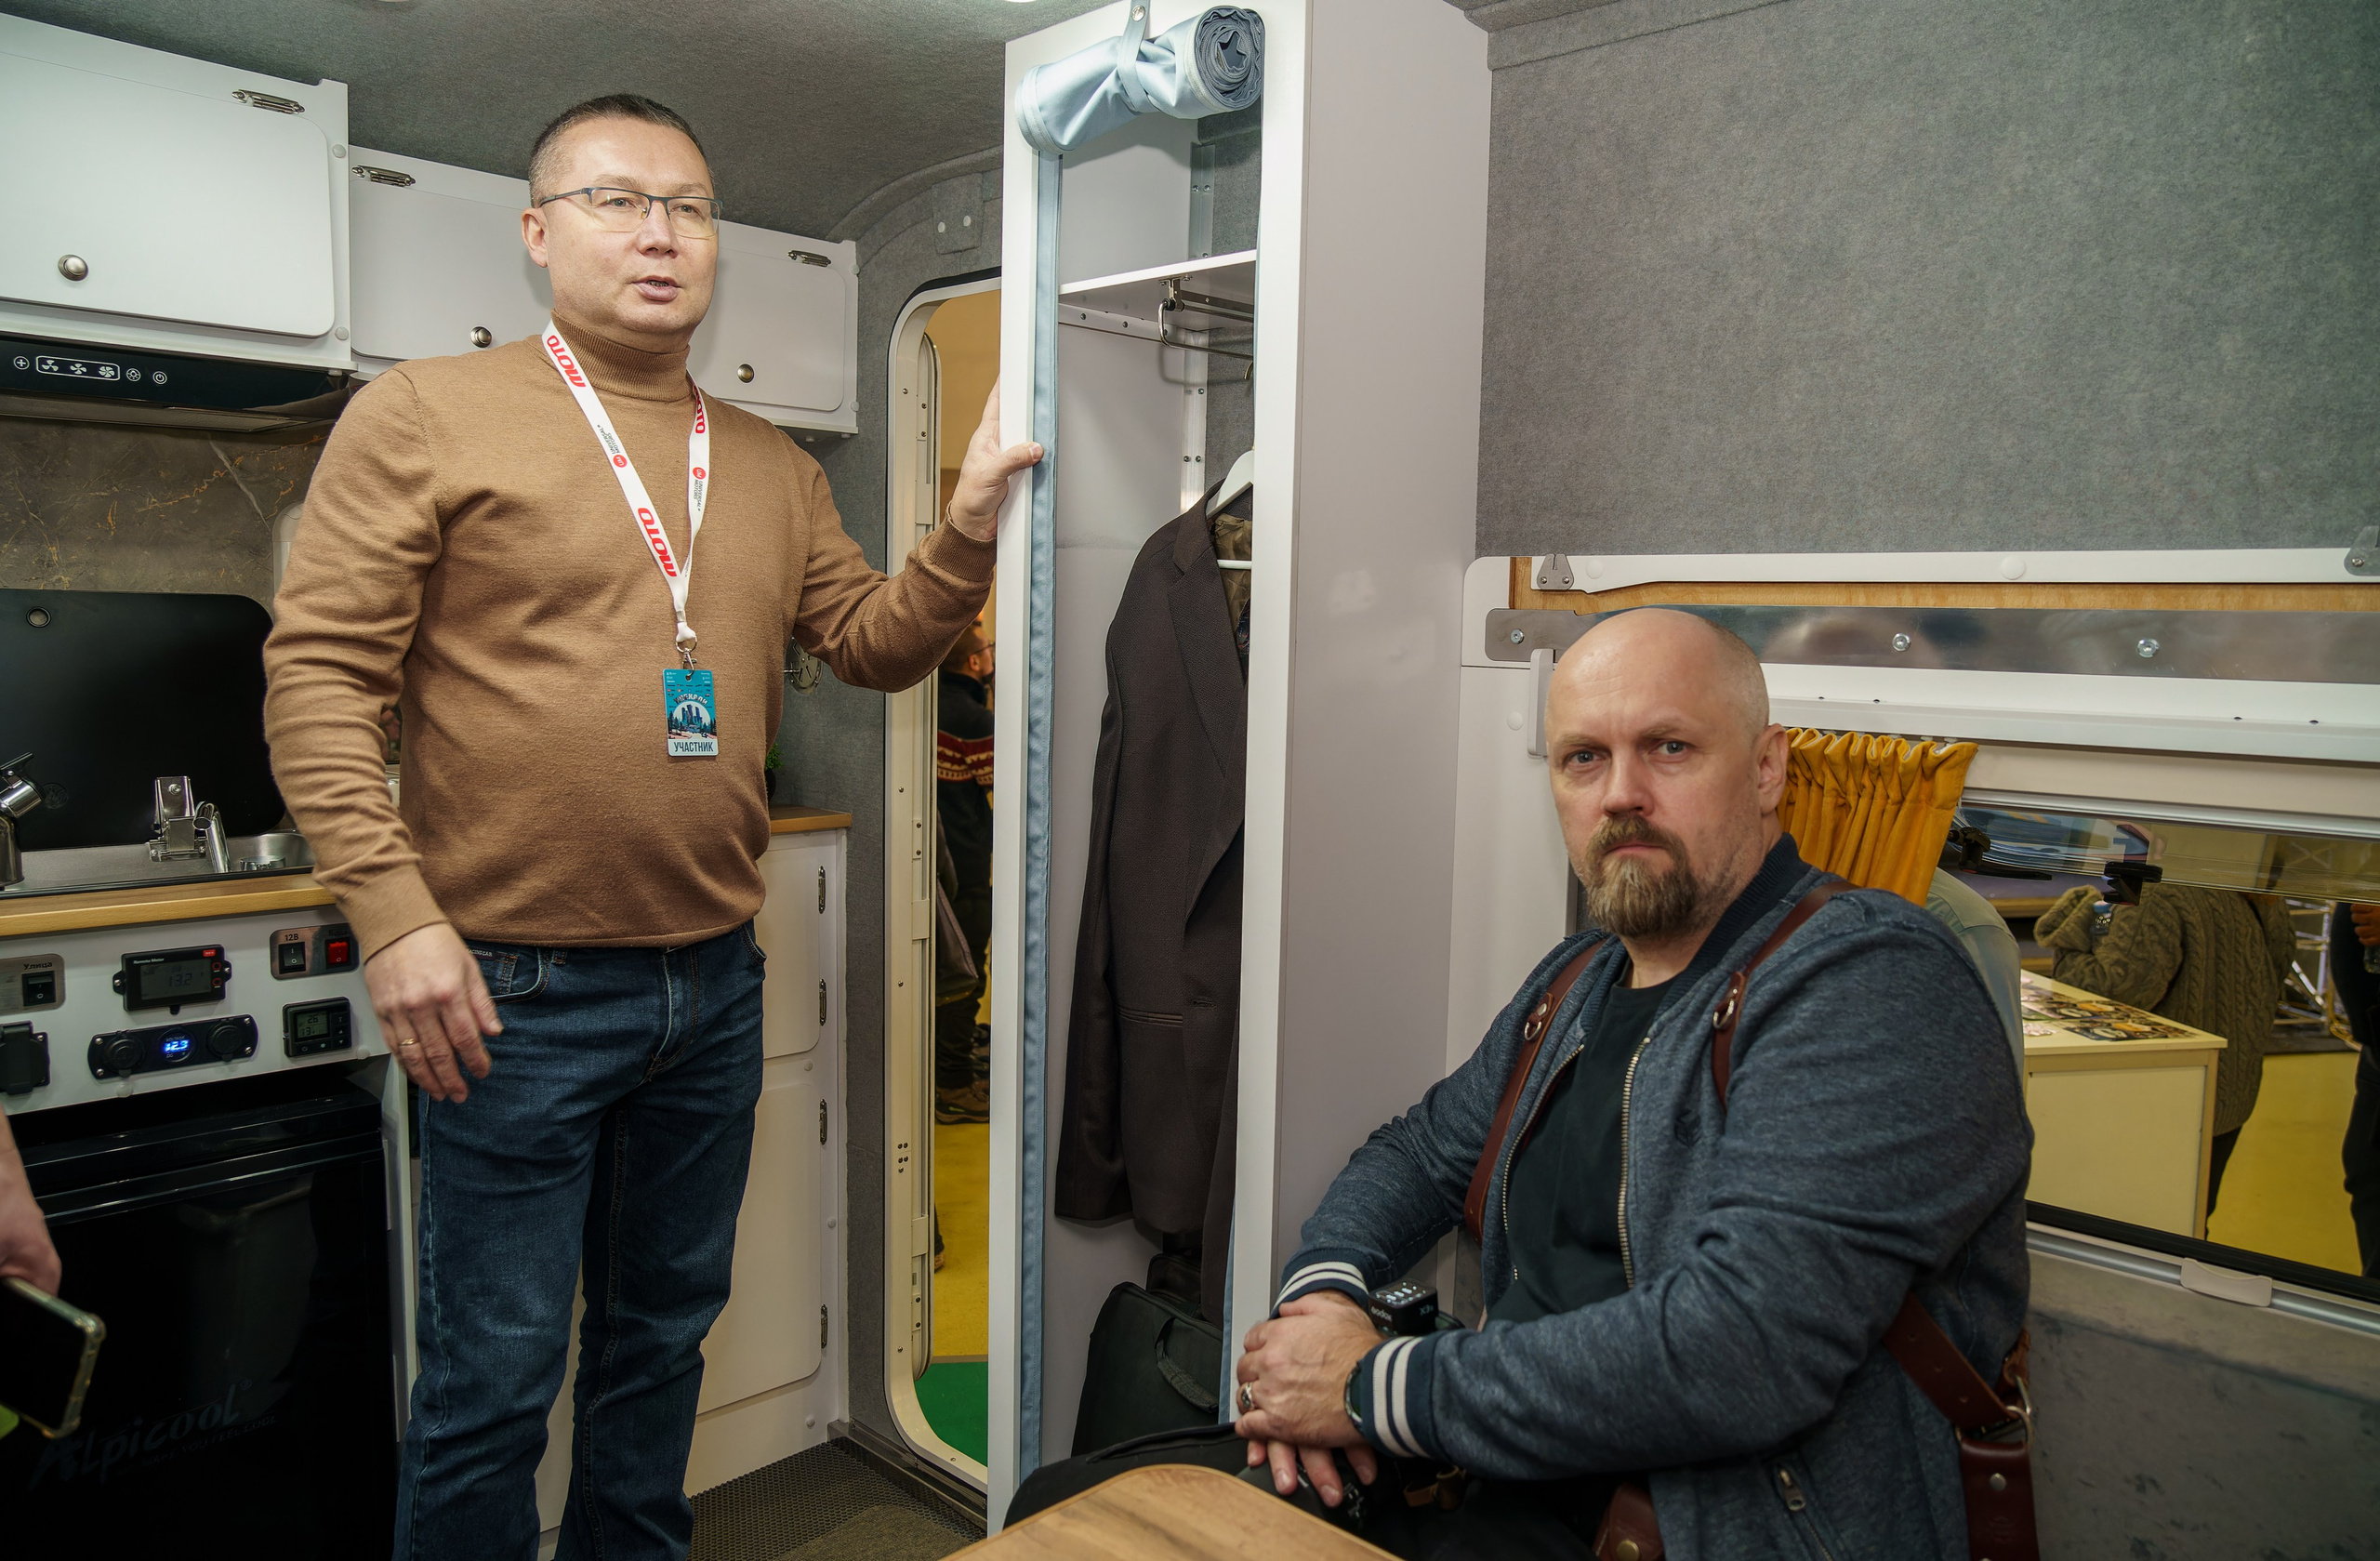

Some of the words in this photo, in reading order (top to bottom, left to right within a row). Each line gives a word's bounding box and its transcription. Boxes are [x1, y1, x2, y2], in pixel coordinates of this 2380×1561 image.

[547, 335, 587, 388] MOTO
[637, 507, 678, 577] MOTO
[674, 742, 713, 752] УЧАСТНИК
